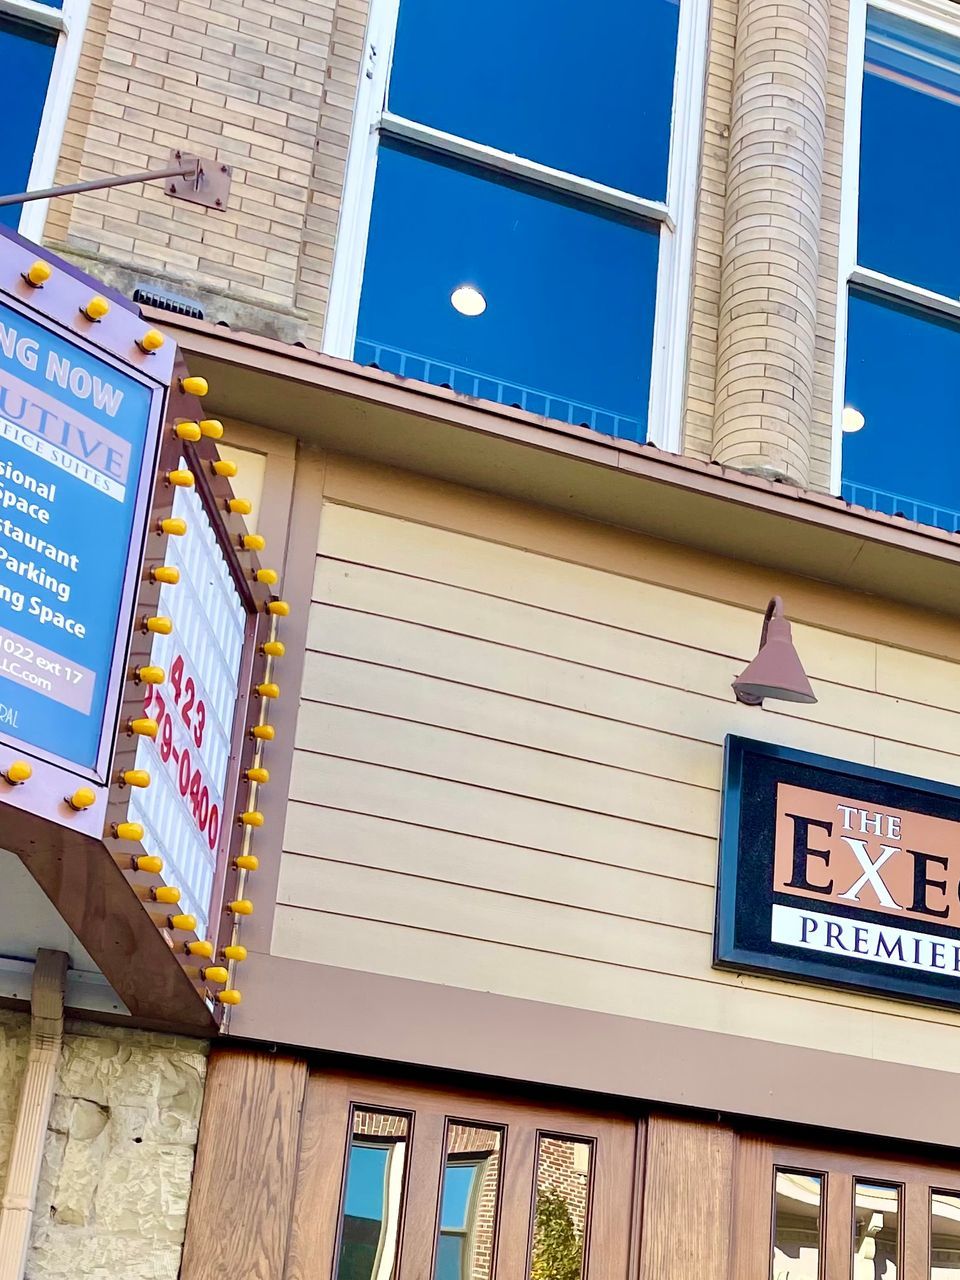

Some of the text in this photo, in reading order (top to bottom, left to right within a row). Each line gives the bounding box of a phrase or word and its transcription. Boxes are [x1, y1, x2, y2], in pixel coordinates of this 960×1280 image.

[46, 350, 124, 417] NOW
[0, 386, 124, 479] UTIVE
[51, 449, 112, 492] SUITES
[0, 518, 79, 572] taurant
[28, 596, 86, 638] Space
[36, 656, 61, 676] ext
[65, 667, 84, 685] 17
[171, 654, 206, 749] 423
[837, 804, 902, 841] THE
